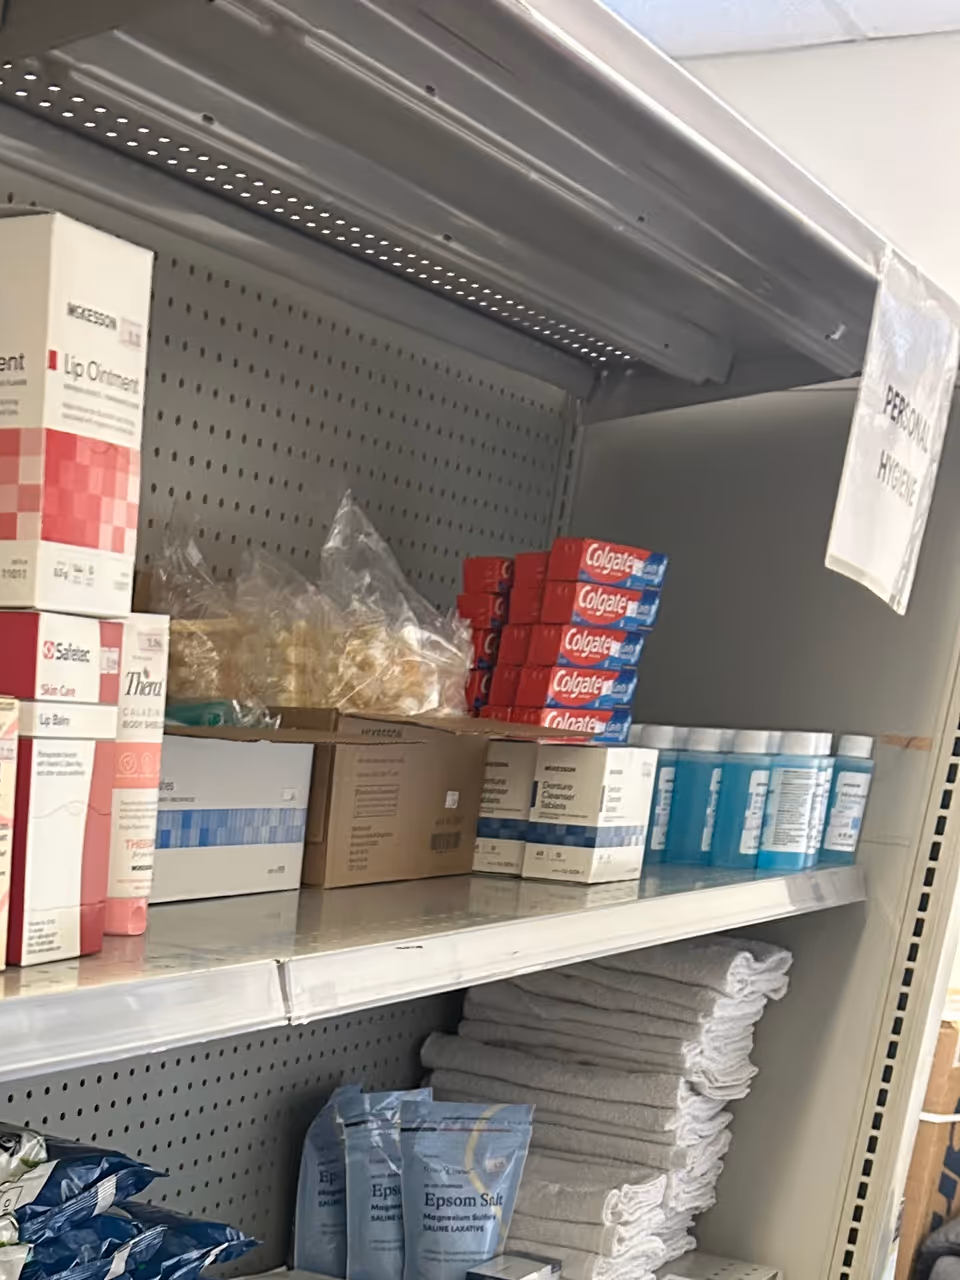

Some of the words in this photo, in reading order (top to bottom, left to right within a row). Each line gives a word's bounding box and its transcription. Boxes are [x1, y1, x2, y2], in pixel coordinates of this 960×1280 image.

[64, 352, 84, 382] Lip
[86, 360, 140, 396] Ointment
[882, 383, 931, 454] PERSONAL
[876, 448, 918, 508] HYGIENE
[586, 542, 634, 575] Colgate
[578, 585, 628, 617] Colgate
[55, 641, 90, 663] Safetec
[565, 627, 611, 658] Colgate
[41, 682, 58, 696] Skin
[60, 684, 76, 698] Care
[125, 670, 164, 697] Thera
[553, 669, 602, 699] Colgate
[40, 713, 51, 728] Lip
[53, 714, 70, 727] Balm
[544, 711, 597, 732] Colgate
[540, 791, 575, 802] Cleanser
[542, 780, 574, 792] Denture
[540, 801, 567, 811] Tablets
[424, 1192, 477, 1211] Epsom
[480, 1191, 504, 1208] Salt
[423, 1212, 471, 1224] Magnesium
[423, 1224, 450, 1233] SALINE
[451, 1225, 485, 1233] LAXATIVE
